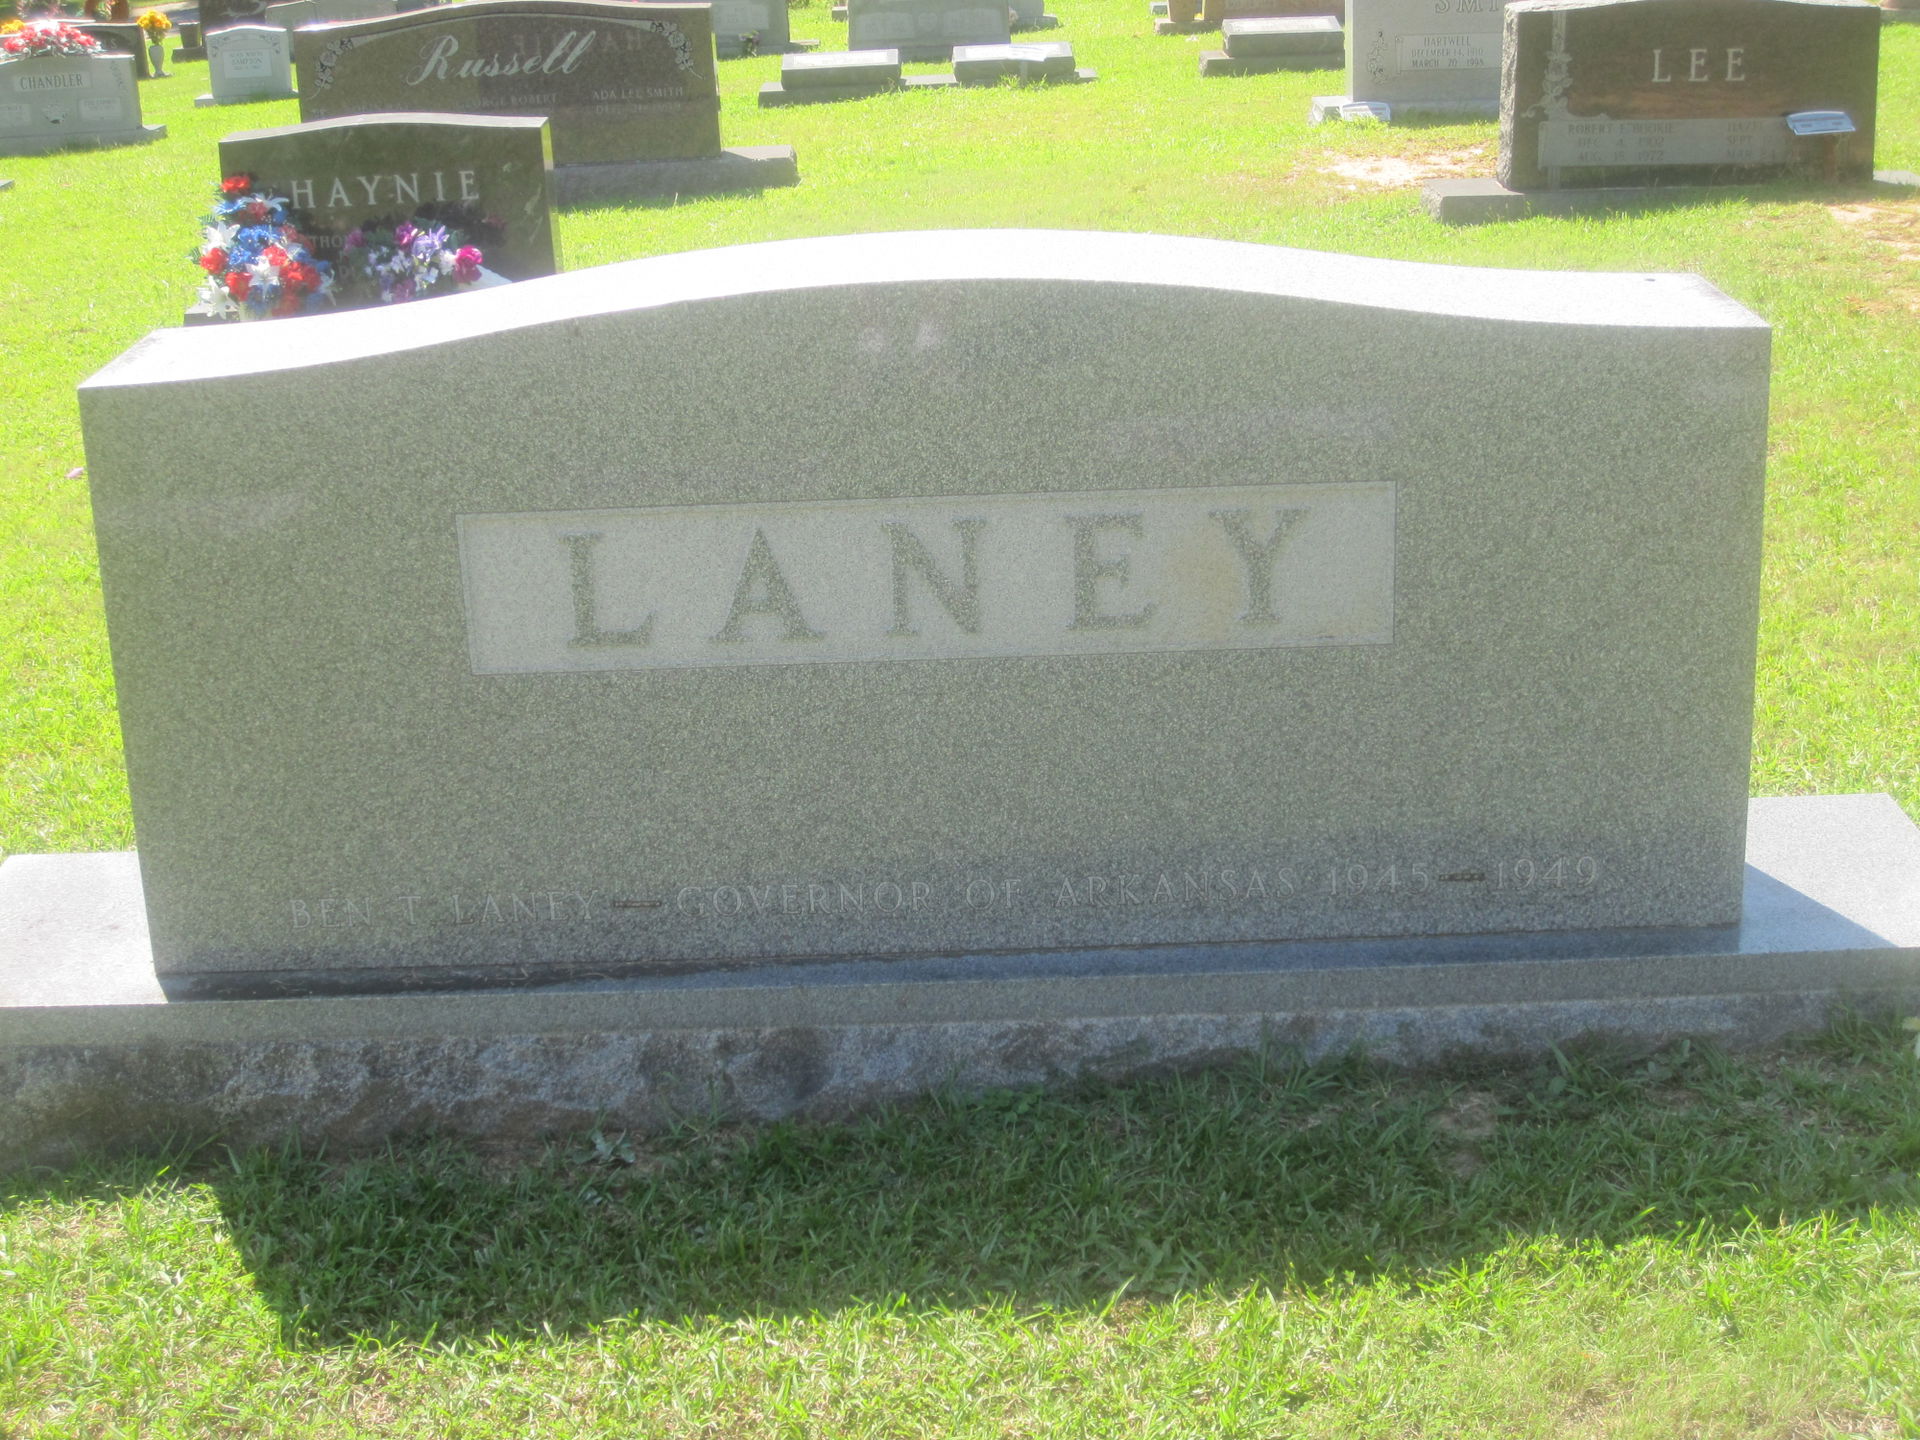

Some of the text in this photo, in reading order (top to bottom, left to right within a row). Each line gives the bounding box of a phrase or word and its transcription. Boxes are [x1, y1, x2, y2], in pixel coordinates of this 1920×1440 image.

[406, 30, 597, 85] Russell
[1423, 35, 1471, 47] HARTWELL
[19, 73, 84, 90] CHANDLER
[1651, 48, 1746, 83] LEE
[646, 86, 684, 98] SMITH
[290, 170, 480, 209] HAYNIE
[558, 508, 1311, 647] LANEY
[290, 896, 372, 929] BEN
[451, 889, 599, 927] LANEY
[676, 881, 933, 917] GOVERNOR
[966, 878, 1022, 911] OF
[1054, 867, 1298, 908] ARKANSAS
[1327, 861, 1430, 896] 1945
[1494, 855, 1601, 890] 1949
